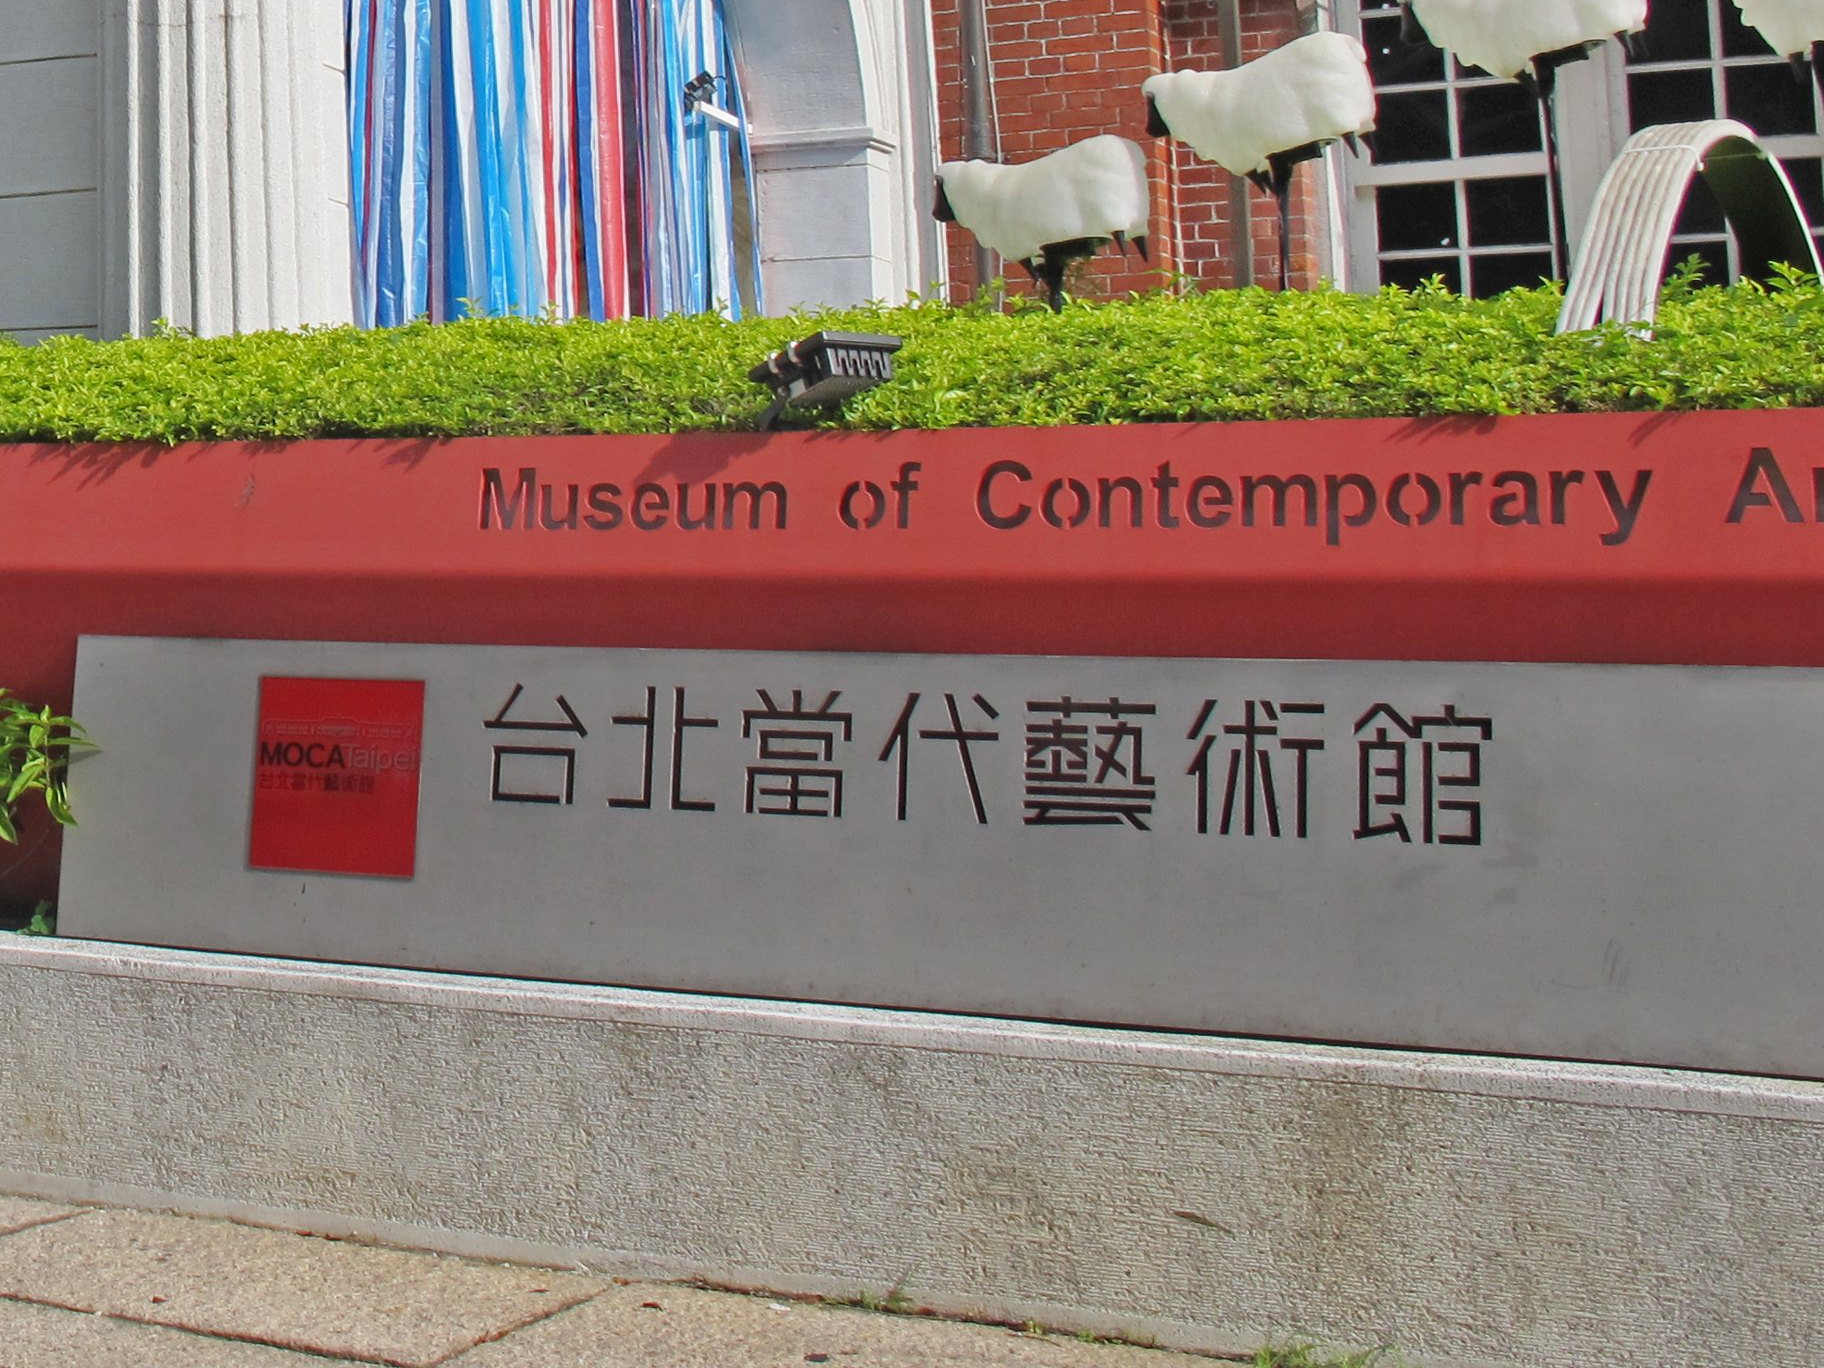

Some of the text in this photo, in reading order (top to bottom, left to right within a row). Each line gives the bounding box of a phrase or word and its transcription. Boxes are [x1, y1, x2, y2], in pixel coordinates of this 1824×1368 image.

[480, 467, 788, 531] Museum
[838, 462, 922, 530] of
[975, 459, 1654, 548] Contemporary
[482, 683, 1493, 847] 台北當代藝術館
